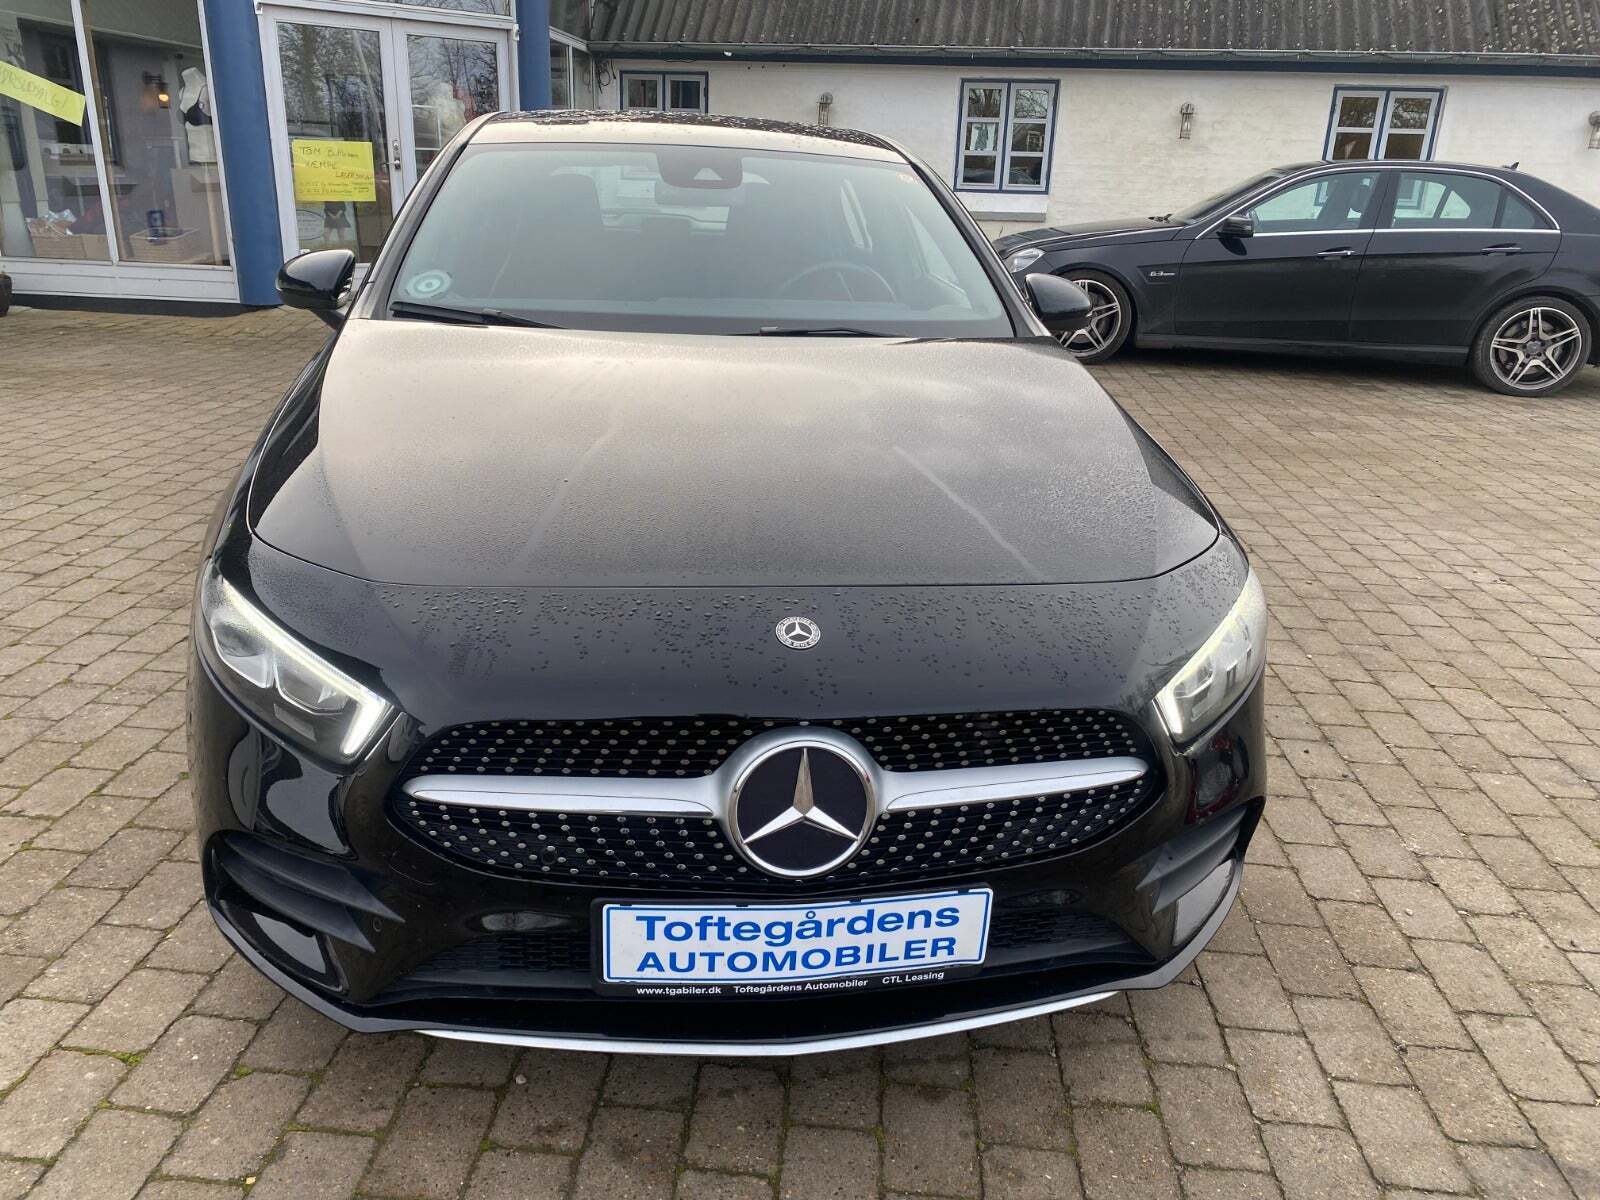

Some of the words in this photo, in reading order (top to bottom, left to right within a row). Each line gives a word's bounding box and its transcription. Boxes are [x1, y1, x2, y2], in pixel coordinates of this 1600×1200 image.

[635, 907, 960, 947] Toftegårdens
[636, 937, 957, 973] AUTOMOBILER
[636, 986, 722, 996] www.tgabiler.dk
[733, 983, 802, 995] Toftegårdens
[804, 979, 869, 992] Automobiler
[881, 976, 903, 985] CTL
[905, 971, 945, 982] Leasing
